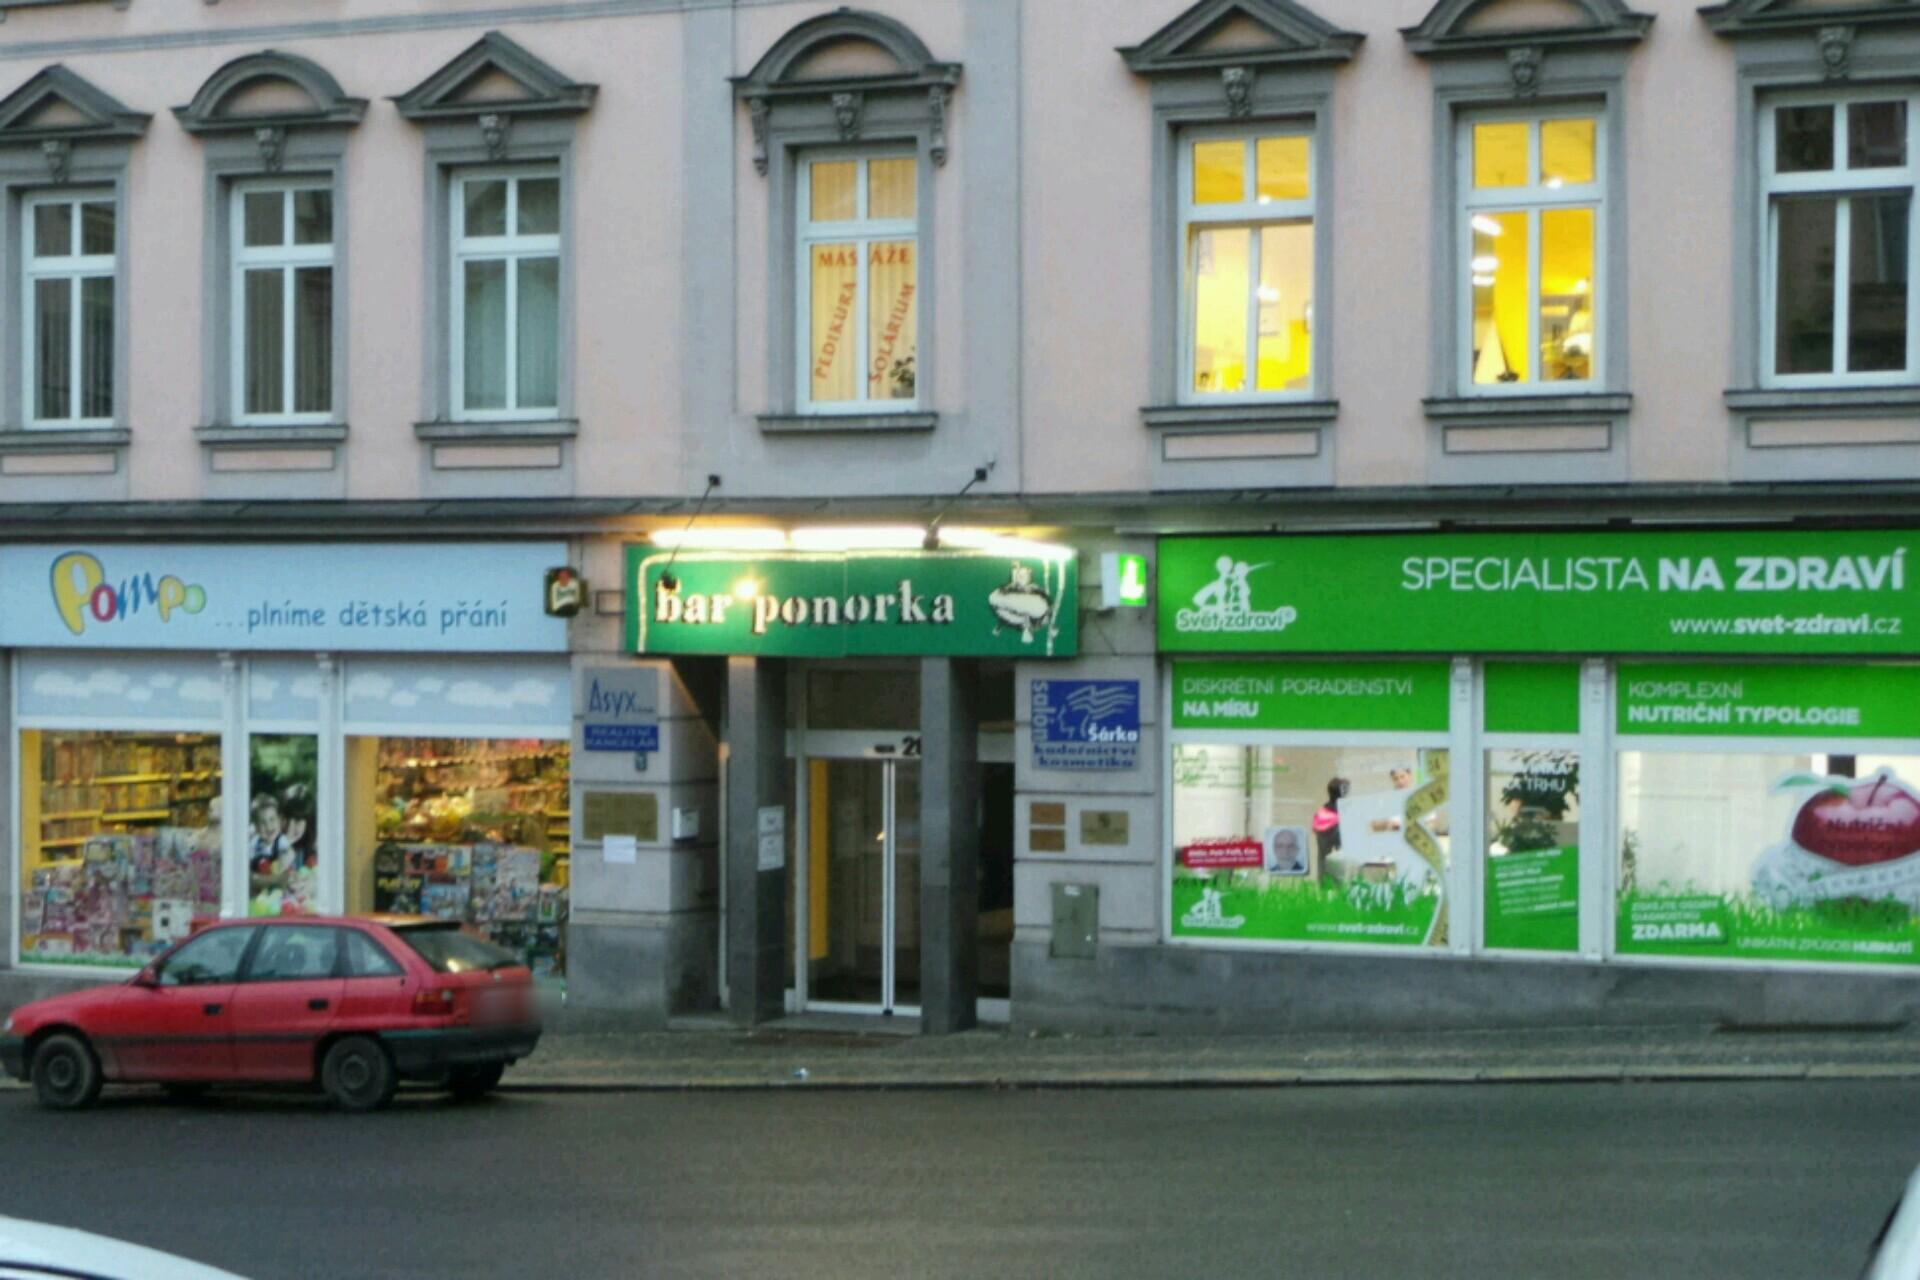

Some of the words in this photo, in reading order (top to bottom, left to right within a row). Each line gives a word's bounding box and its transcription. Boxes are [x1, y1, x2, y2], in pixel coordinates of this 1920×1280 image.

[1401, 556, 1650, 592] SPECIALISTA
[1657, 556, 1726, 592] NA
[1734, 547, 1907, 592] ZDRAVÍ
[49, 550, 206, 636] Pompo
[338, 600, 428, 628] dětská
[440, 598, 508, 635] přání
[655, 577, 734, 623] bar
[751, 579, 956, 635] ponorka
[1669, 612, 1903, 635] www.svet-zdravi.cz
[1281, 676, 1414, 696] PORADENSTVÍ
[1628, 679, 1744, 700] KOMPLEXNÍ
[1182, 699, 1210, 718] NA
[1212, 697, 1260, 718] MÍRU
[1628, 702, 1731, 724] NUTRIČNÍ
[1734, 706, 1862, 726] TYPOLOGIE
[1632, 921, 1722, 940] ZDARMA
